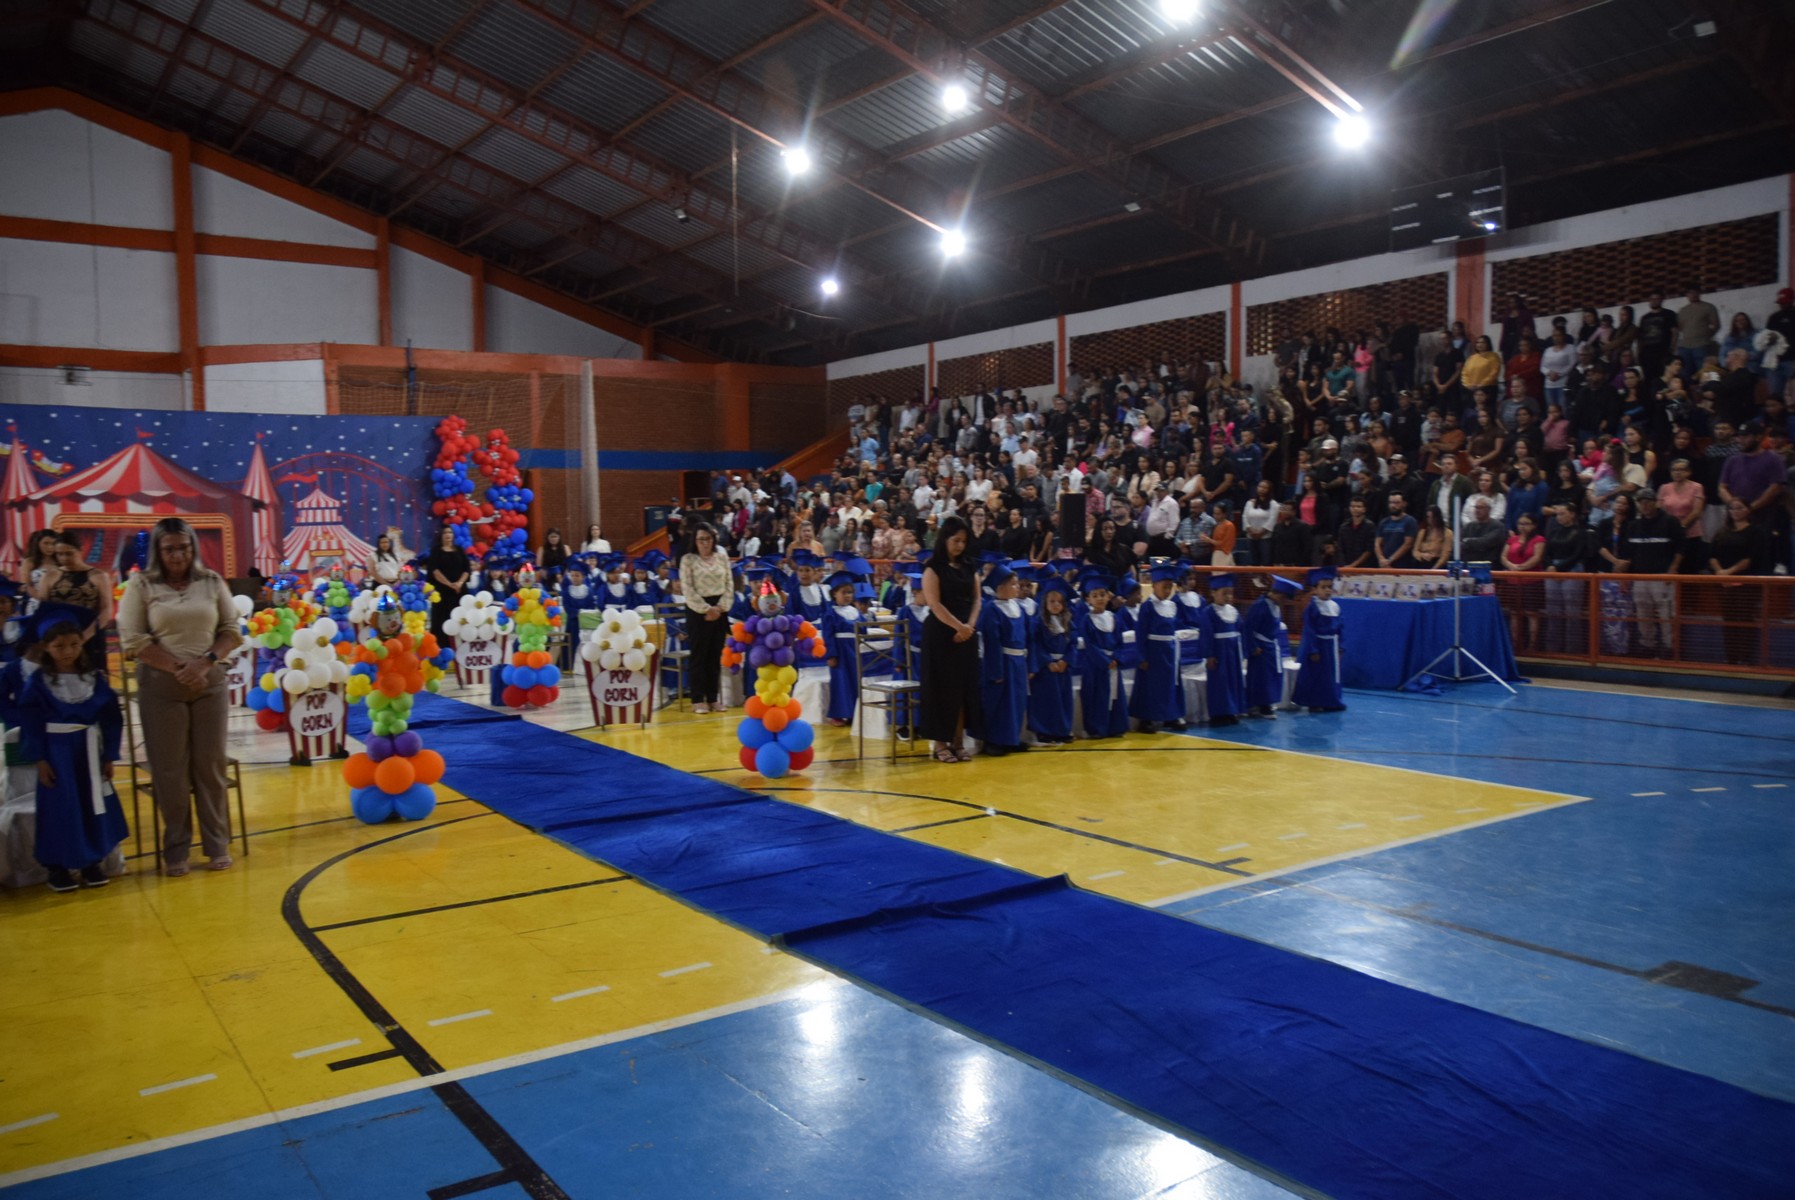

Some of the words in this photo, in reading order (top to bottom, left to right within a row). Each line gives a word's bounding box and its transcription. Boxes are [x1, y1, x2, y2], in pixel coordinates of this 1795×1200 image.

[470, 641, 487, 652] POP
[466, 655, 492, 666] CORN
[609, 670, 632, 683] POP
[604, 687, 638, 702] CORN
[306, 693, 327, 711] POP
[301, 713, 333, 732] CORN
